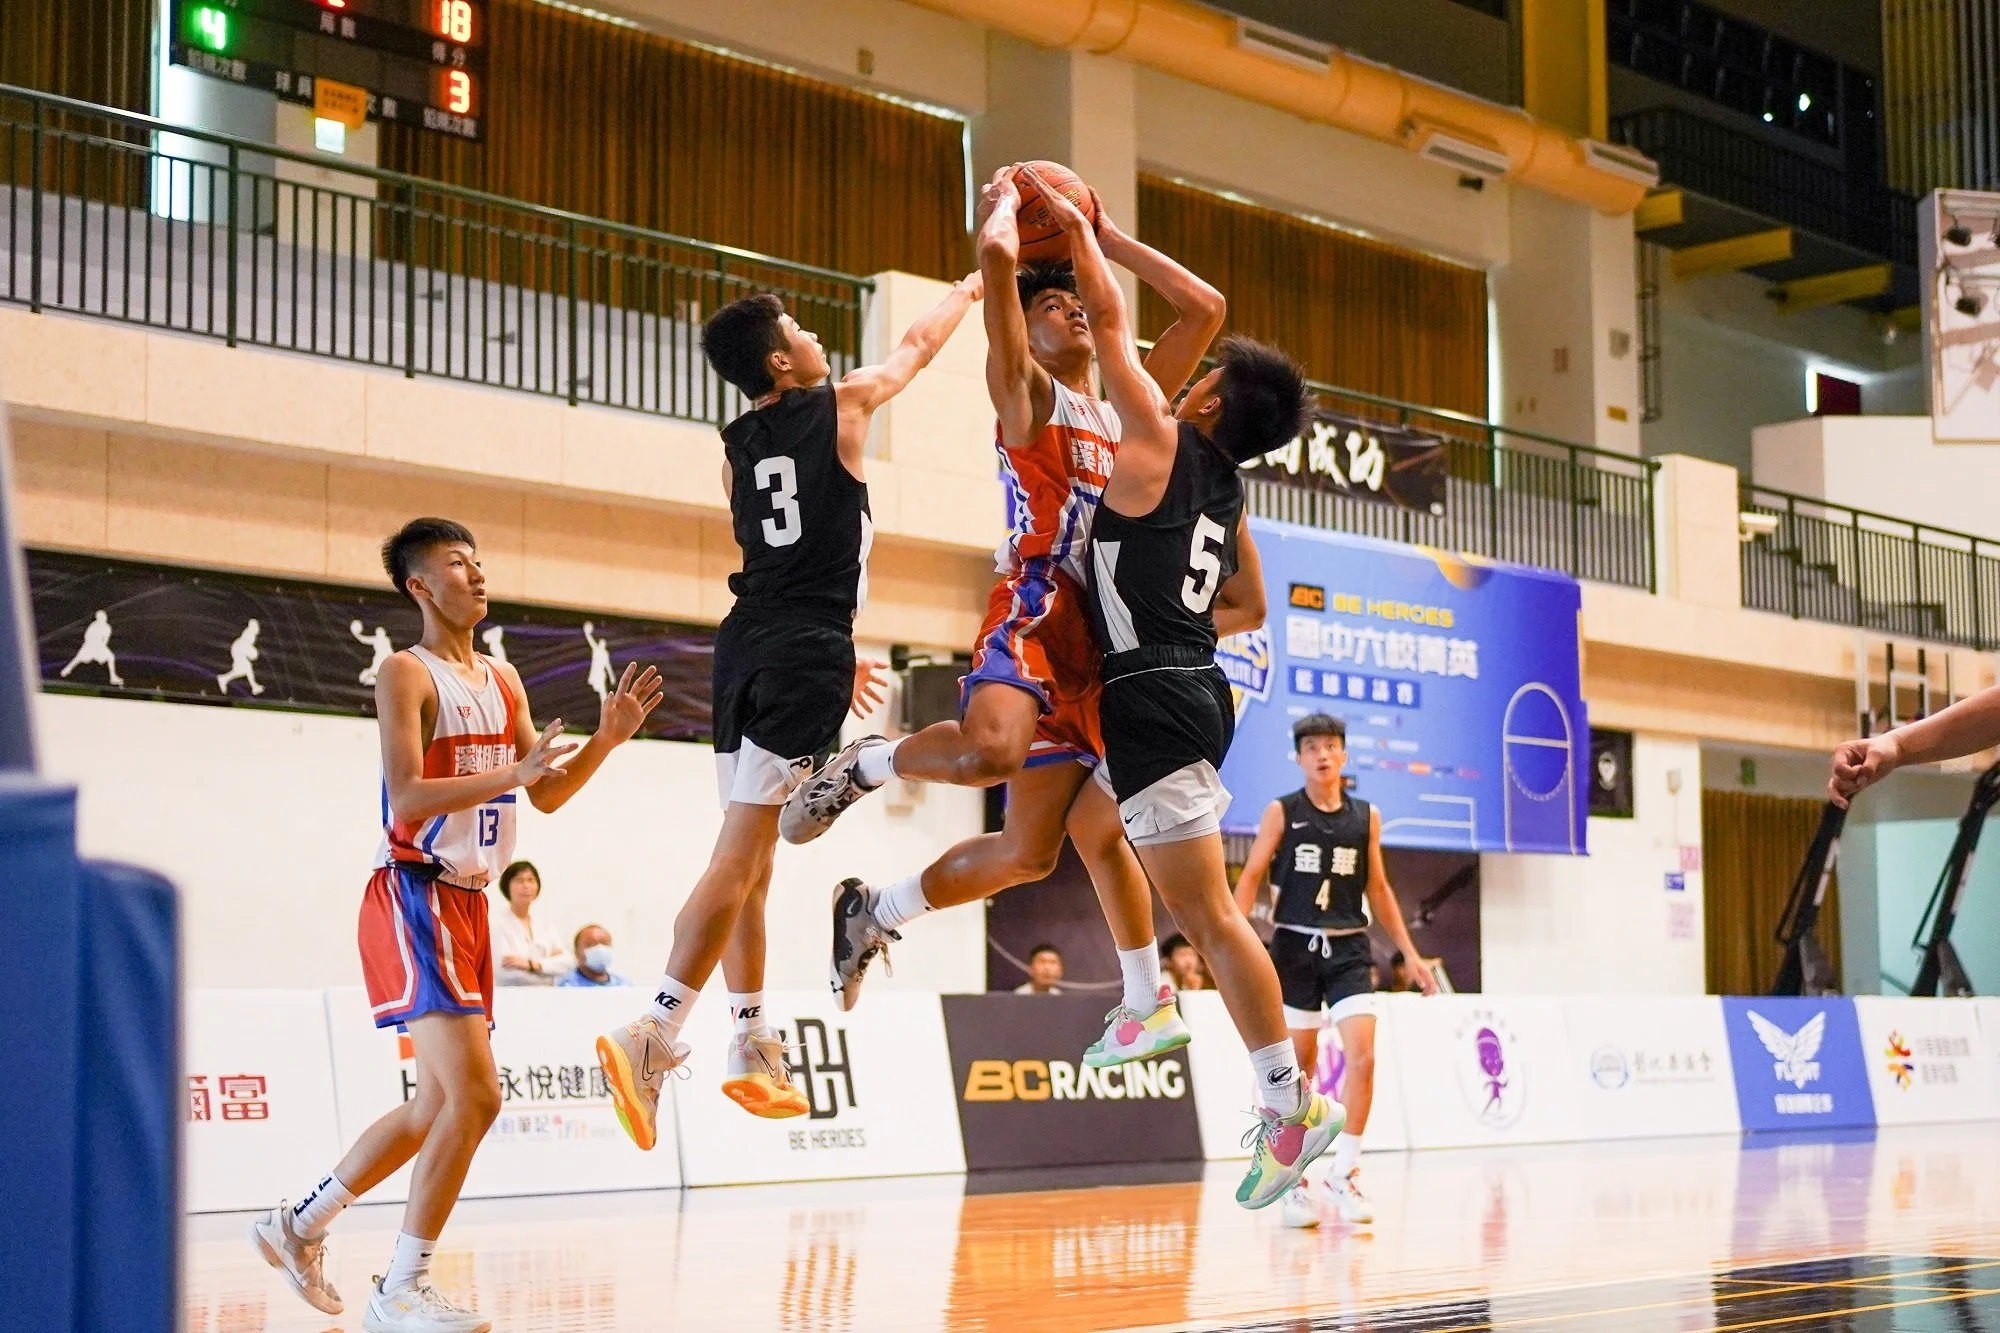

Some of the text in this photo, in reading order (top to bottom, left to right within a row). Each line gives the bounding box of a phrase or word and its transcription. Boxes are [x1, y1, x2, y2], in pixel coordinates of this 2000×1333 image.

[201, 7, 227, 50] 4
[440, 0, 471, 43] 18
[449, 70, 470, 113] 3
[753, 455, 802, 548] 3
[1181, 512, 1226, 614] 5
[1333, 592, 1362, 615] BE
[1366, 598, 1455, 629] HEROES
[478, 808, 499, 847] 13
[1314, 878, 1332, 912] 4
[787, 1126, 867, 1151] BE HEROES
